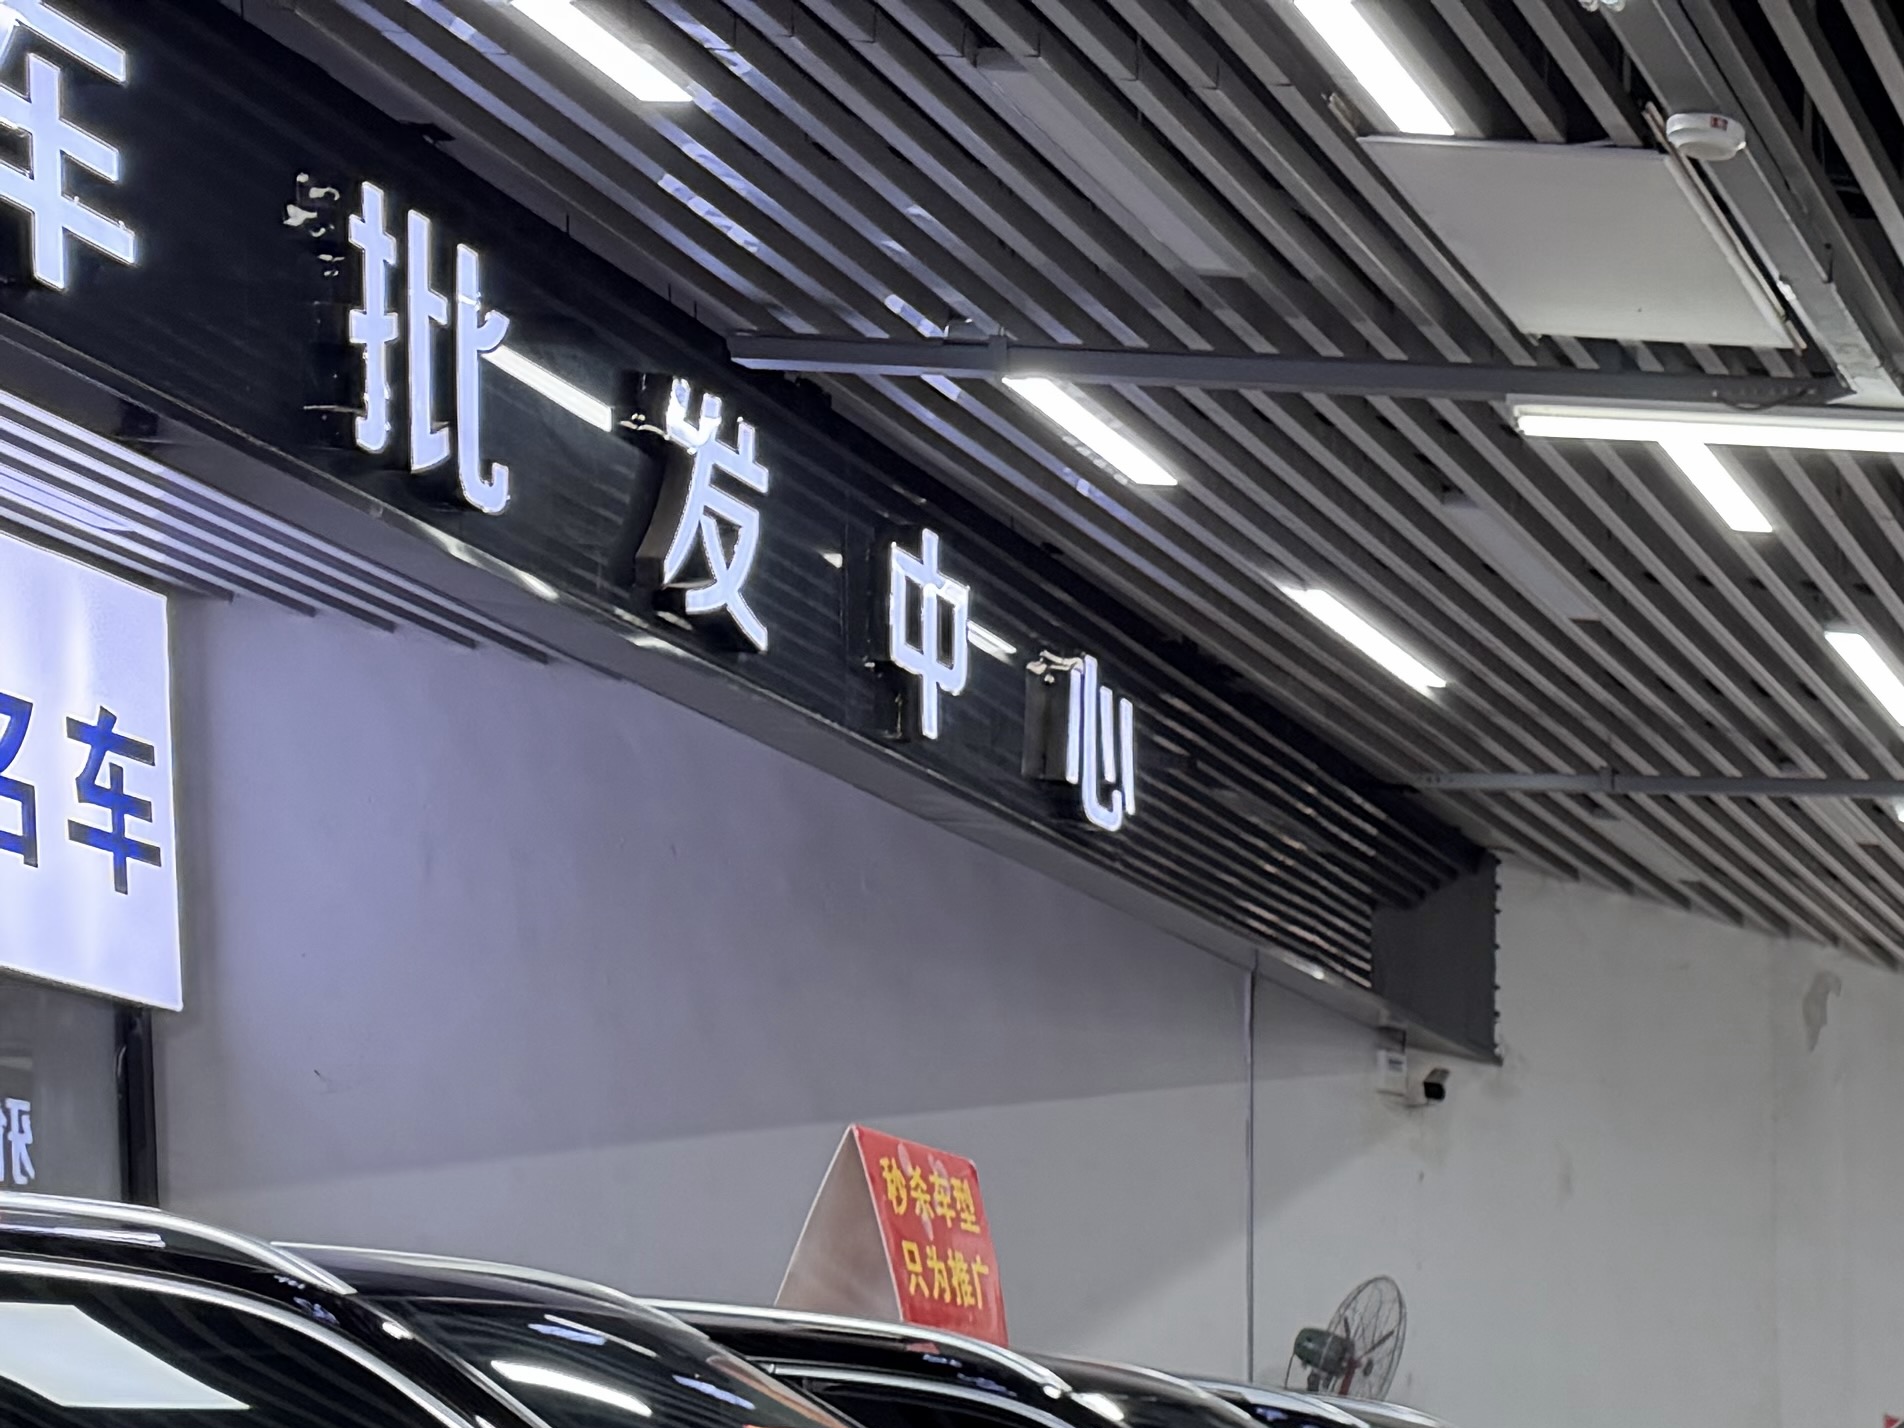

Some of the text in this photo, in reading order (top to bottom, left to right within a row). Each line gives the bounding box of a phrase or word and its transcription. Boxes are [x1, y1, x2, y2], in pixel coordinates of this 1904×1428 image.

[879, 1156, 981, 1235] 秒杀车型
[902, 1239, 990, 1311] 只为推广
